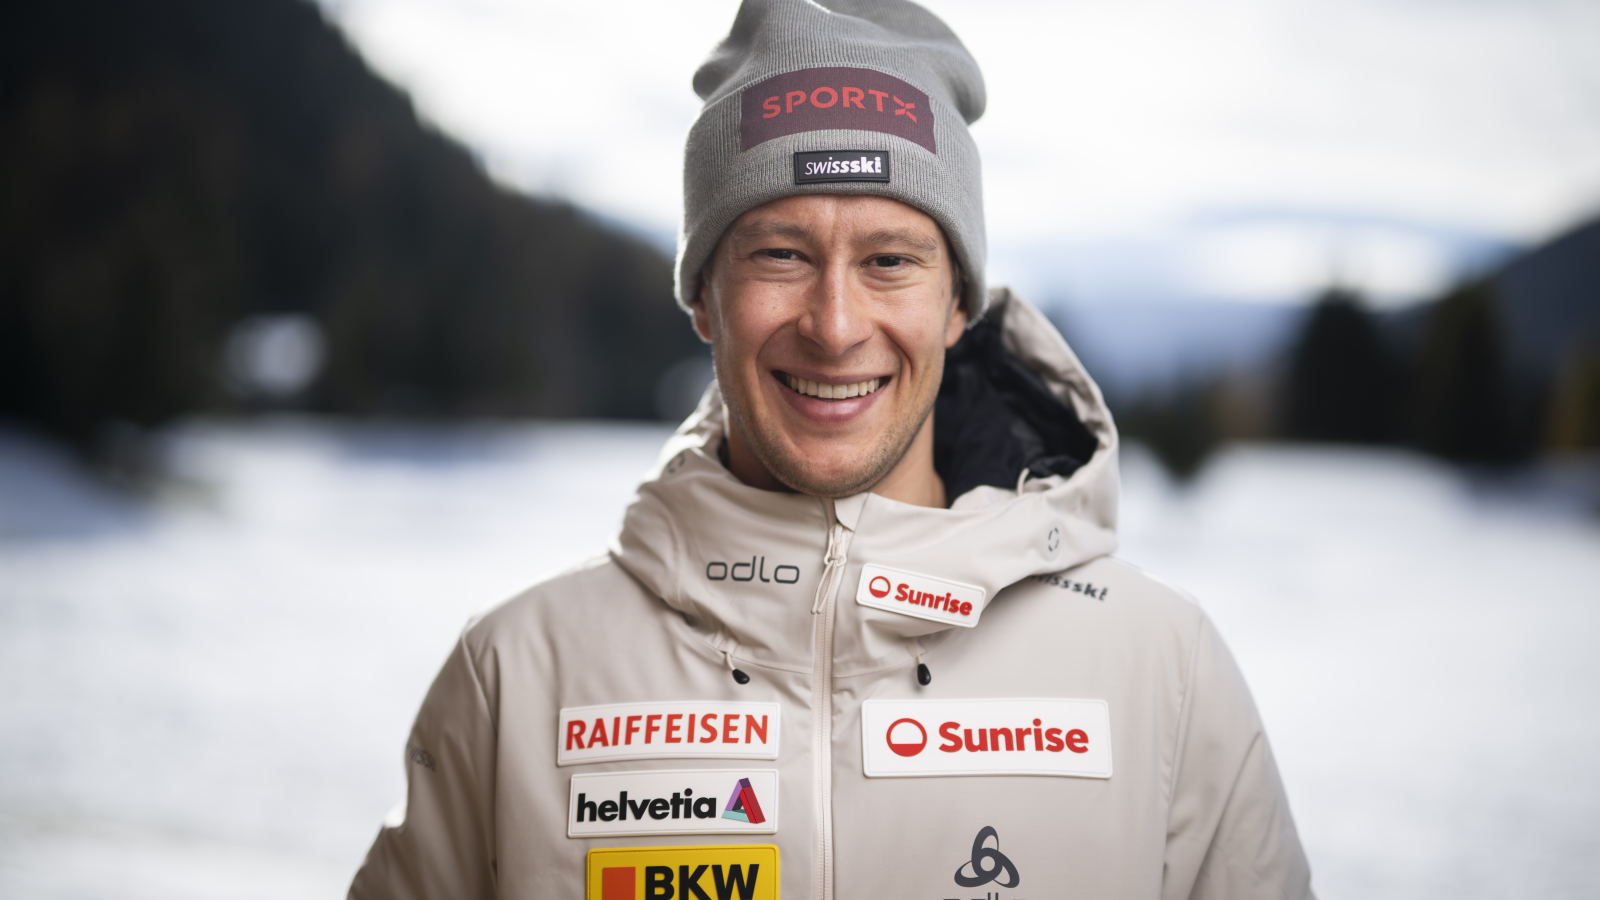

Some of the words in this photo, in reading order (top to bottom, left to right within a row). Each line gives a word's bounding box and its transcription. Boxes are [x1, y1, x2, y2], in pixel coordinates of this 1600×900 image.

[805, 156, 882, 176] swissski
[706, 555, 800, 585] odlo
[894, 583, 973, 616] Sunrise
[565, 713, 768, 751] RAIFFEISEN
[938, 718, 1089, 754] Sunrise
[576, 788, 717, 822] helvetia
[645, 863, 760, 900] BKW
